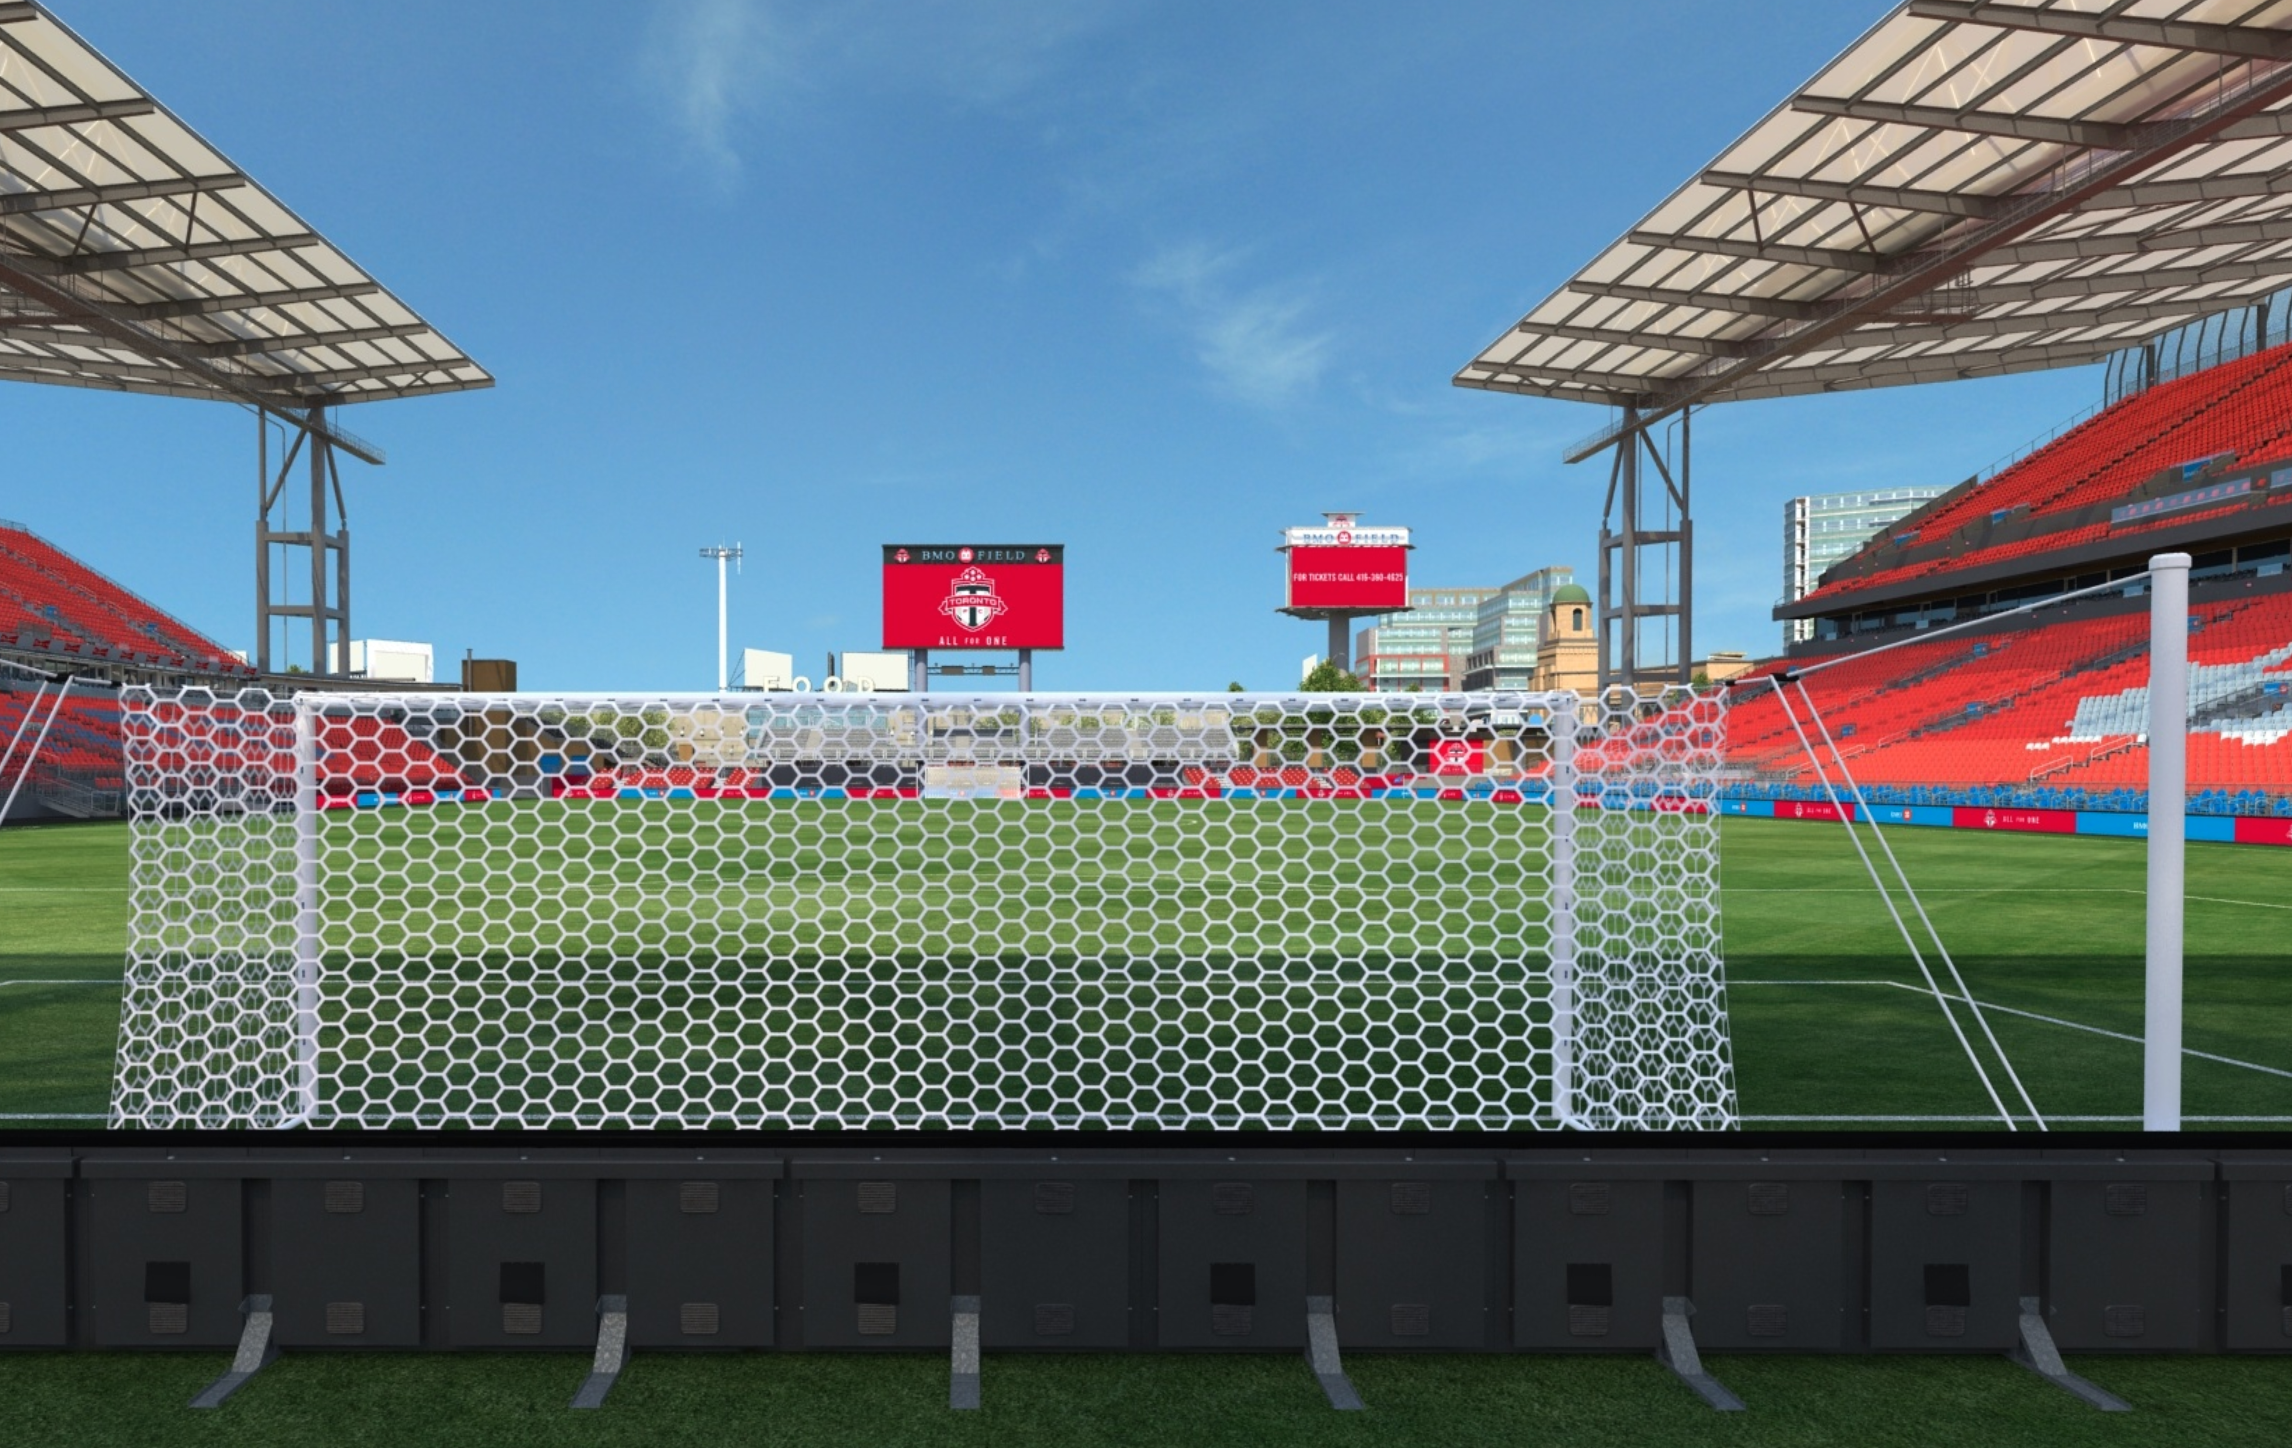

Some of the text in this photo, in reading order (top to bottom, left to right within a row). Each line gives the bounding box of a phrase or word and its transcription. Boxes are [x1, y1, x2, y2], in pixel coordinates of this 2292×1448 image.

[1303, 533, 1400, 543] BMO FIELD
[922, 550, 1026, 560] BMO FIELD
[1293, 573, 1308, 582] FOR
[1309, 573, 1336, 582] TICKETS
[1337, 573, 1355, 582] CALL
[949, 596, 997, 606] TORONTO
[938, 636, 1008, 645] ALL FOR ONE
[763, 676, 875, 693] FOOD
